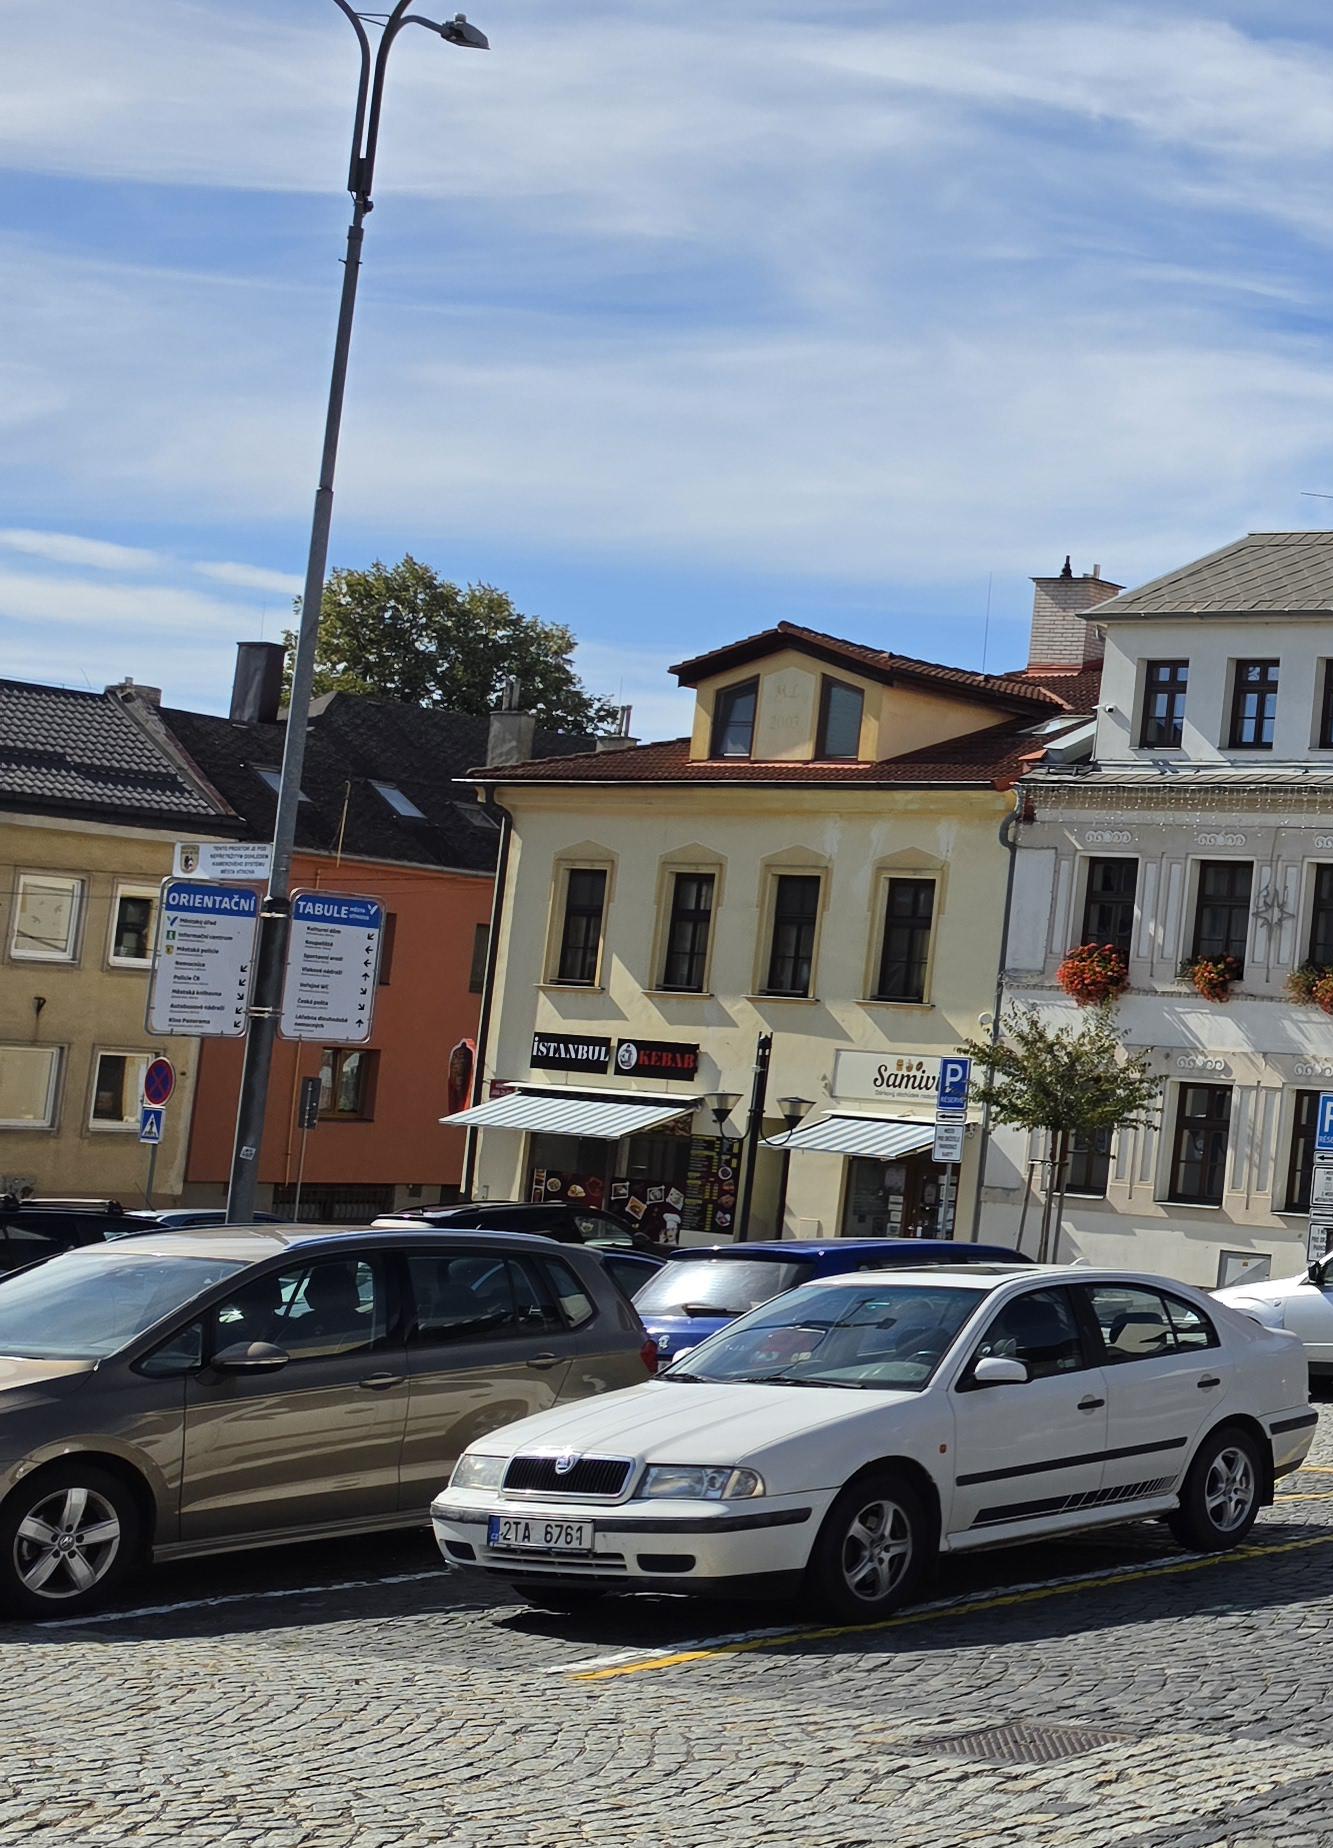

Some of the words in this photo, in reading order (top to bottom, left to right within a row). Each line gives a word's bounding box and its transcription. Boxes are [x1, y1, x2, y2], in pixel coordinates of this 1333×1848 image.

[168, 892, 256, 912] ORIENTAČNÍ
[298, 901, 349, 918] TABULE
[639, 1049, 696, 1069] KEBAB
[946, 1064, 962, 1092] P
[502, 1521, 531, 1543] 2TA
[544, 1523, 583, 1546] 6761
